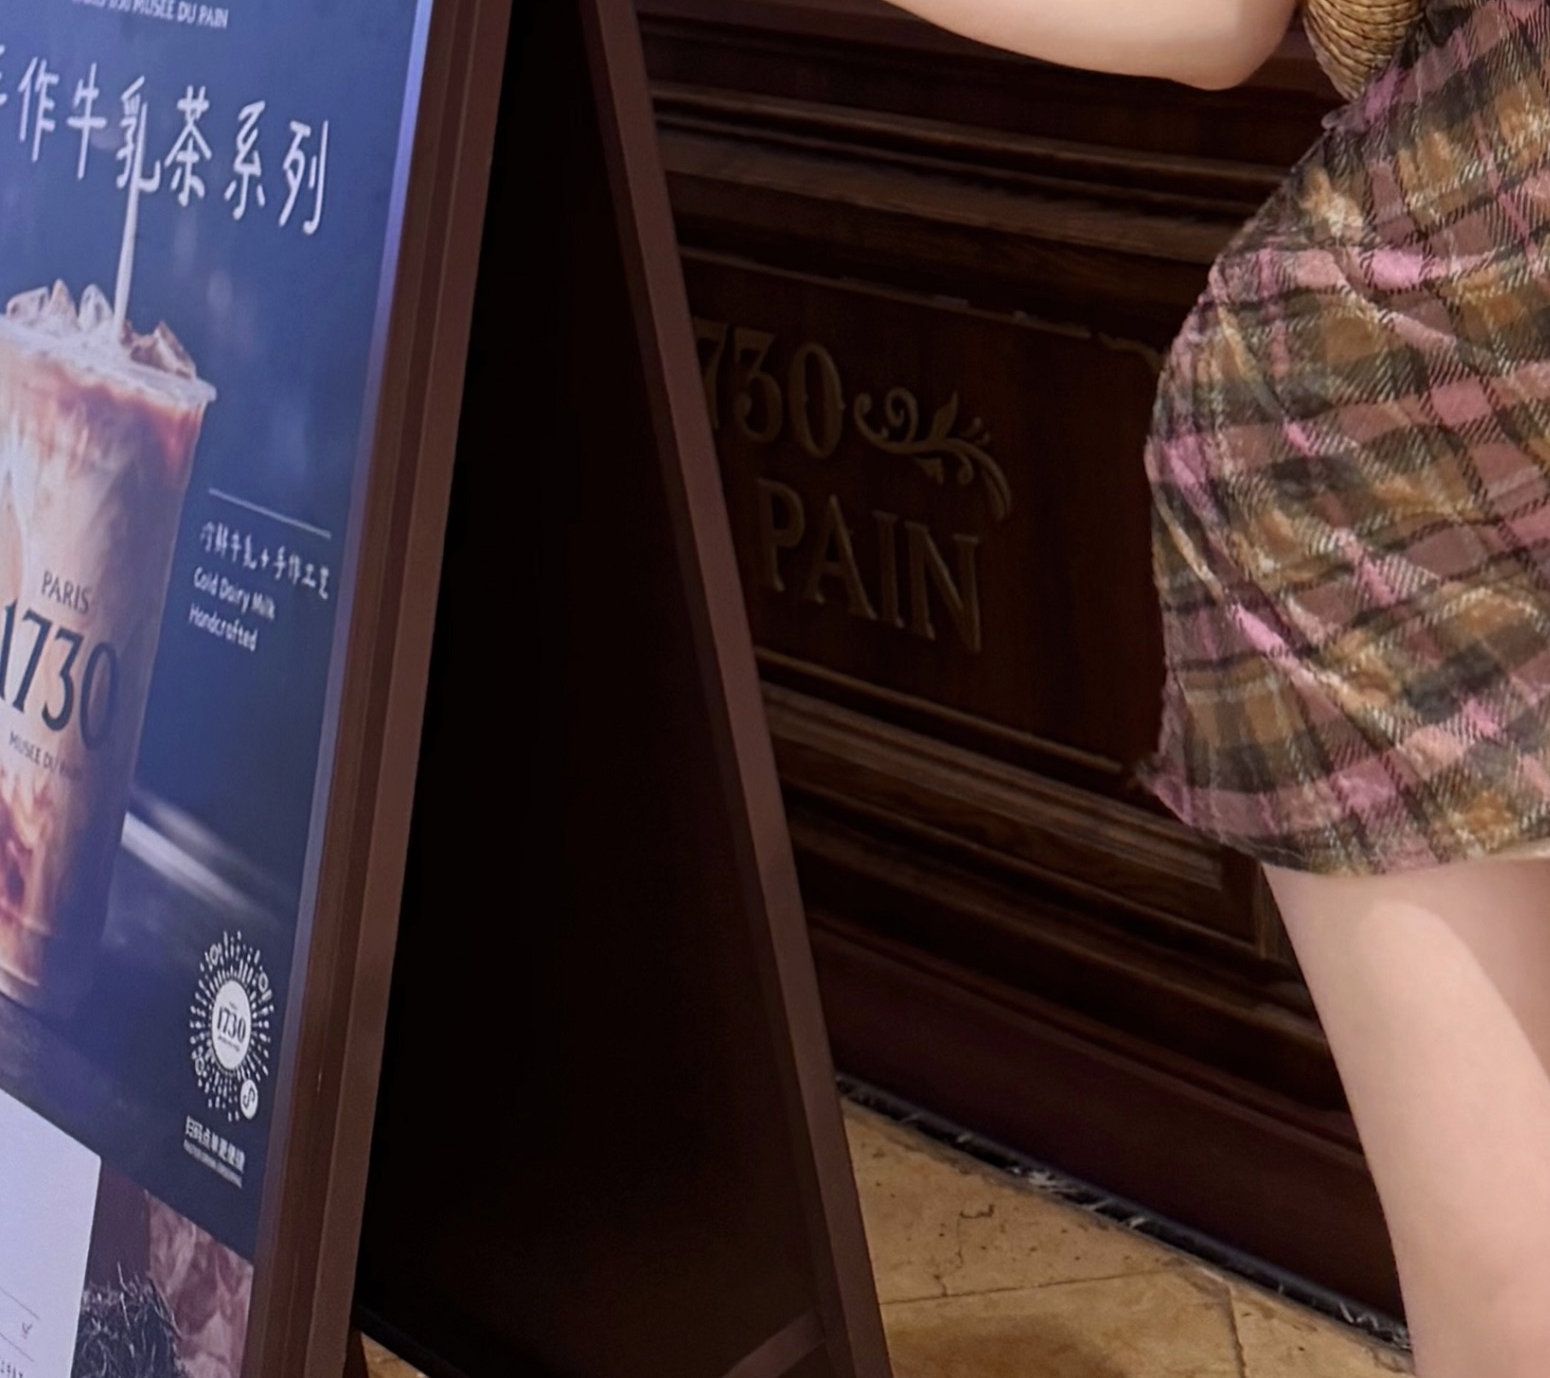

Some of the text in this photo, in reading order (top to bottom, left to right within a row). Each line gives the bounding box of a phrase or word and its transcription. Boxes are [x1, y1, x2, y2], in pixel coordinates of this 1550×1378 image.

[176, 0, 198, 25] DU
[198, 4, 230, 30] PAIN
[0, 43, 329, 235] 作牛乳茶系列
[40, 569, 92, 616] PARIS
[755, 476, 981, 653] PAIN
[0, 598, 119, 753] 1730
[216, 1005, 247, 1045] 1730
